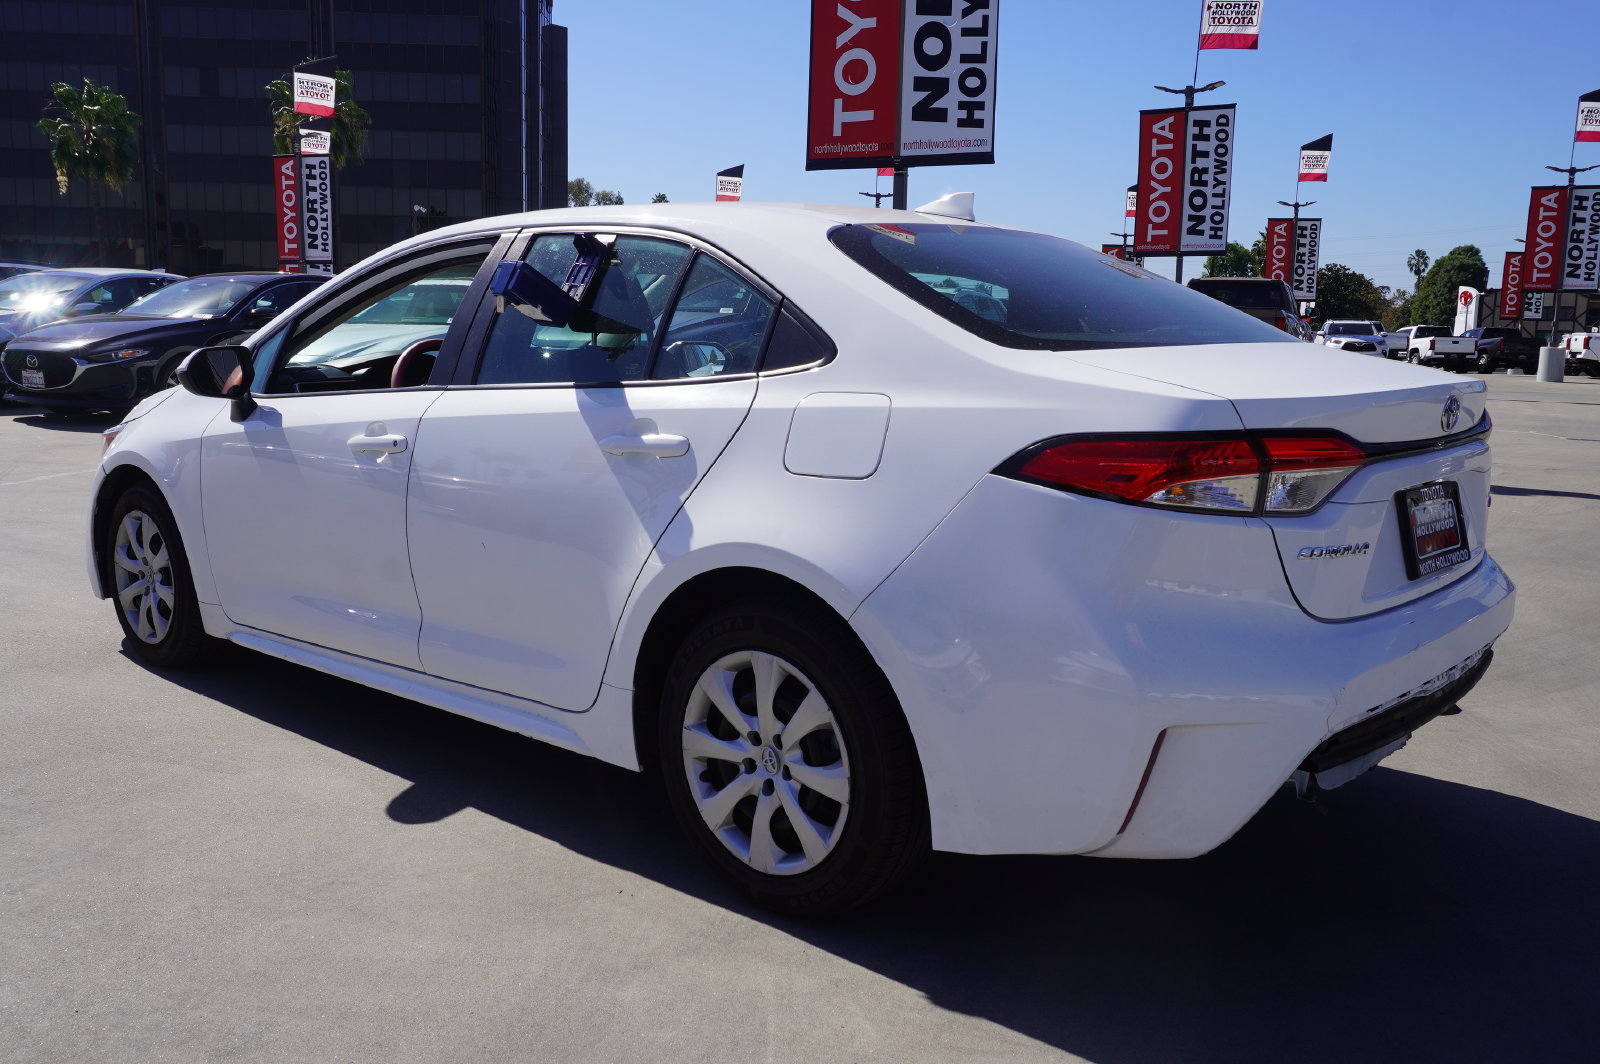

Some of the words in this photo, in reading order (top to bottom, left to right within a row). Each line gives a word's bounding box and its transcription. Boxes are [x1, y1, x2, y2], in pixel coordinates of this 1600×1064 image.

[1210, 16, 1254, 25] TOYOTA
[1215, 2, 1258, 10] NORTH
[833, 0, 877, 137] TOY
[903, 137, 988, 152] northhollywoodtoyota.com
[1586, 107, 1600, 115] NO
[281, 159, 298, 253] TOYOTA
[305, 163, 319, 250] NORTH
[318, 159, 330, 253] HOLLYWOOD
[1147, 115, 1175, 243] TOYOTA
[1186, 119, 1212, 237] NORTH
[1208, 113, 1230, 240] HOLLYWOOD
[1271, 222, 1288, 281] OYOTA
[1293, 225, 1308, 291] NORTH
[1306, 223, 1318, 293] HOLLYWOOD
[1532, 191, 1560, 283] TOYOTA
[1565, 194, 1590, 279] NORTH
[1583, 191, 1600, 282] HOLLYWOOD
[1506, 255, 1522, 314] TOYOTA
[1421, 485, 1445, 500] TOYOTA
[1416, 519, 1454, 537] HOLLYWOOD
[1420, 559, 1436, 575] NORTH
[1437, 550, 1468, 568] HOLLYWOOD
